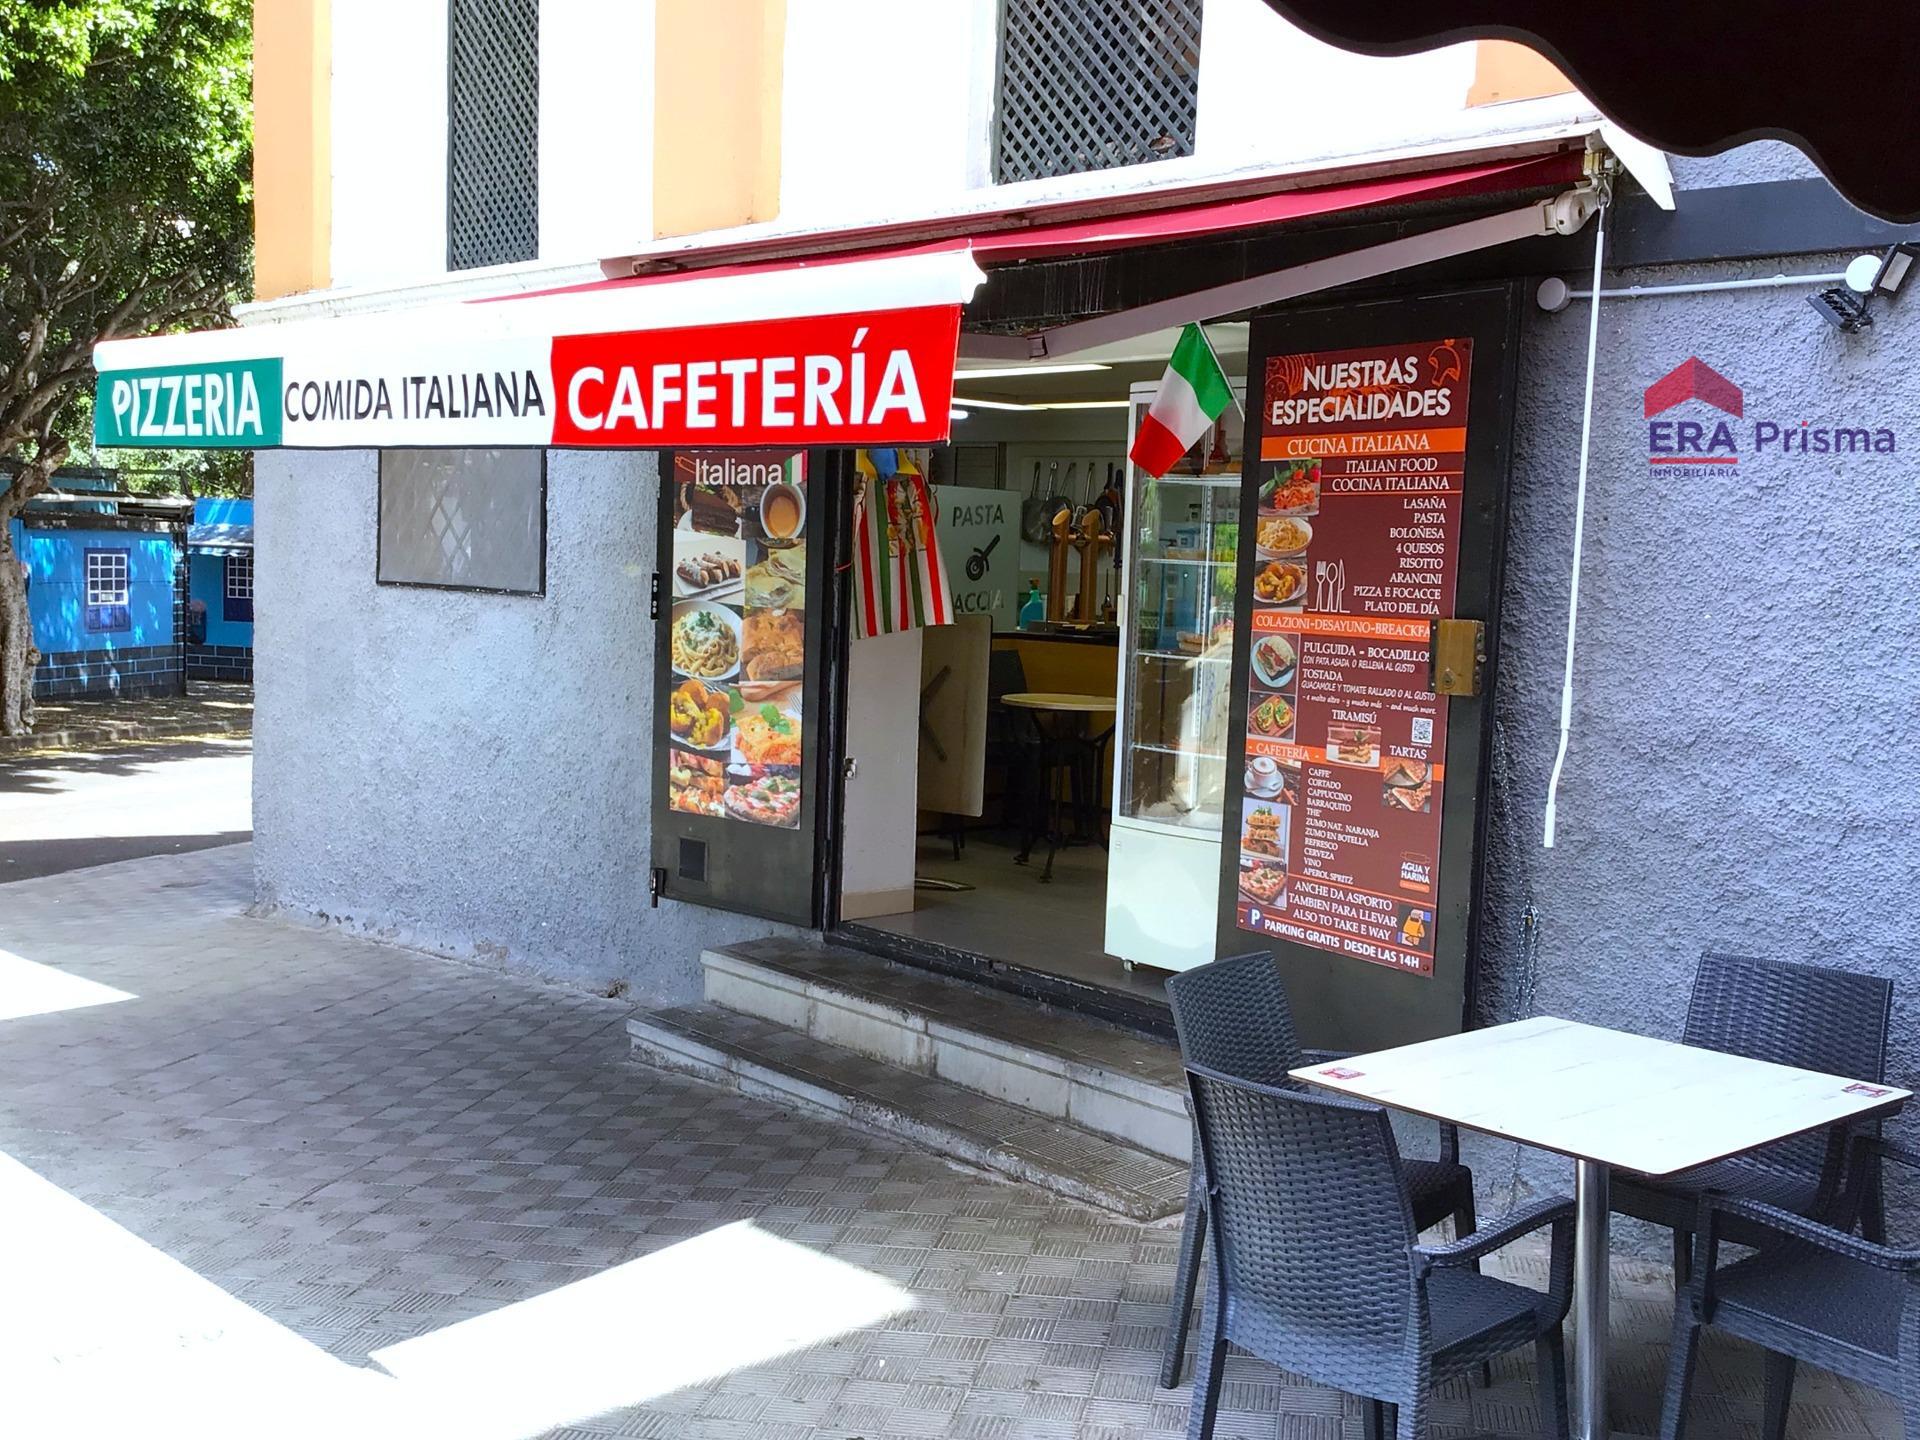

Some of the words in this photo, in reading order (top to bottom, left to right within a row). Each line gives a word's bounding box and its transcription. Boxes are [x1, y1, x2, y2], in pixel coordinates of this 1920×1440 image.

[568, 327, 926, 432] CAFETERÍA
[1303, 356, 1418, 392] NUESTRAS
[284, 377, 392, 423] COMIDA
[402, 369, 546, 421] ITALIANA
[113, 371, 263, 437] PIZZERIA
[1272, 387, 1451, 426] ESPECIALIDADES
[1287, 437, 1347, 455] CUCINA
[1351, 433, 1430, 453] ITALIANA
[695, 458, 782, 485] Italiana
[1346, 459, 1396, 473] ITALIAN
[1400, 457, 1438, 471] FOOD
[1332, 478, 1382, 491] COCINA
[1385, 475, 1450, 490] ITALIANA
[1403, 496, 1447, 509] LASAÑA
[952, 504, 1004, 527] PASTA
[1413, 513, 1446, 523] PASTA
[1390, 526, 1445, 539] BOLOÑESA
[1396, 543, 1402, 553] 4
[1403, 543, 1444, 555] QUESOS
[1399, 558, 1444, 569] RISOTTO
[1389, 573, 1442, 584] ARANCINI
[1353, 586, 1382, 597] PIZZA
[1384, 587, 1391, 597] E
[1393, 588, 1441, 600] FOCACCE
[1364, 601, 1397, 612] PLATO
[1398, 602, 1419, 613] DEL
[1420, 601, 1440, 615] DÍA
[1304, 641, 1356, 656] PULGUIDA
[1358, 660, 1385, 670] RELLENA
[1385, 661, 1394, 671] AL
[1394, 662, 1416, 673] GUSTO
[1302, 668, 1343, 681] TOSTADA
[1301, 680, 1336, 692] GUACAMOLE
[1337, 683, 1343, 692] Y
[1343, 684, 1367, 695] TOMATE
[1367, 686, 1397, 698] RALLADO
[1397, 689, 1404, 698] O
[1404, 690, 1413, 699] AL
[1414, 690, 1436, 701] GUSTO
[1332, 709, 1377, 724] TIRAMISÚ
[1256, 742, 1310, 760] CAFETERÍA
[1389, 744, 1427, 760] TARTAS
[1307, 778, 1341, 790] CORTADO
[1307, 788, 1352, 802] CAPPUCCINO
[1306, 797, 1351, 812] BARRAQUITO
[1306, 818, 1327, 828] ZUMO
[1346, 825, 1380, 838] NARANJA
[1305, 827, 1326, 838] ZUMO
[1326, 831, 1337, 840] EN
[1337, 833, 1369, 846] BOTELLA
[1304, 838, 1338, 851] REFRESCO
[1303, 847, 1335, 860] CERVEZA
[1303, 857, 1321, 868] VINO
[1401, 861, 1423, 874] AGUA
[1424, 865, 1431, 875] Y
[1303, 867, 1330, 880] APEROL
[1400, 870, 1430, 884] HARINA
[1295, 880, 1329, 897] ANCHE
[1330, 888, 1345, 901] DA
[1346, 892, 1393, 911] ASPORTO
[1288, 893, 1330, 911] TAMBIEN
[1331, 903, 1358, 919] PARA
[1359, 910, 1398, 928] LLEVAR
[1293, 909, 1318, 922] ALSO
[1318, 913, 1333, 926] TO
[1333, 918, 1359, 933] TAKE
[1360, 924, 1367, 934] E
[1368, 926, 1391, 940] WAY
[1264, 919, 1305, 939] PARKING
[1306, 929, 1340, 948] GRATIS
[1344, 940, 1377, 957] DESDE
[1378, 948, 1397, 962] LAS
[1399, 953, 1419, 969] 14H
